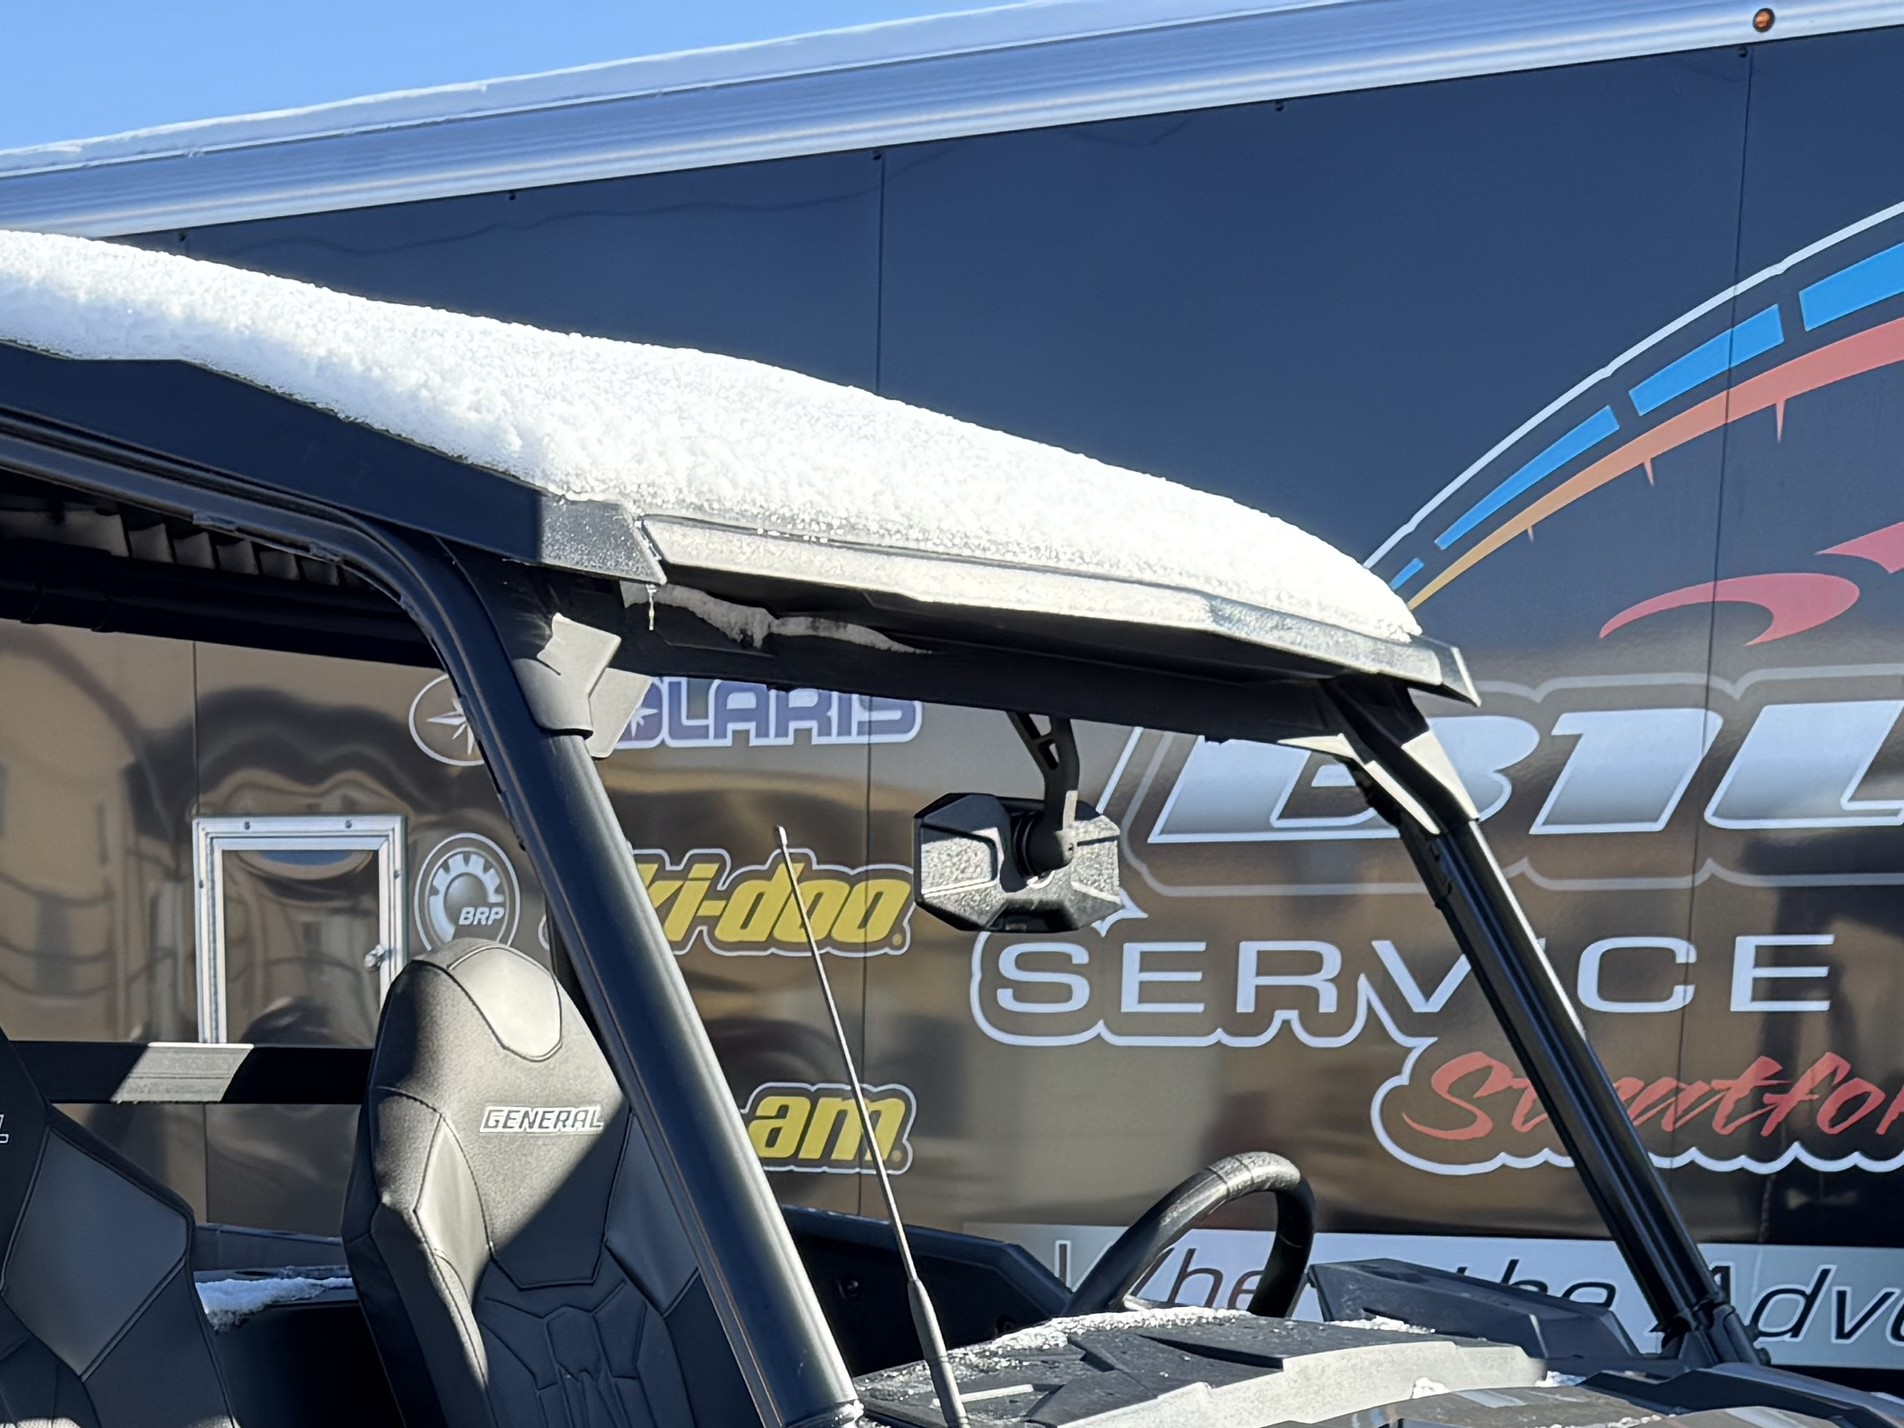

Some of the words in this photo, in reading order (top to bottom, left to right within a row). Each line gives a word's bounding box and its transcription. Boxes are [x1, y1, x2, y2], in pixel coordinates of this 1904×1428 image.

[616, 676, 922, 748] OLARIS
[458, 906, 505, 926] BRP
[995, 931, 1836, 1016] SERVCE
[479, 1104, 604, 1134] GENERAL
